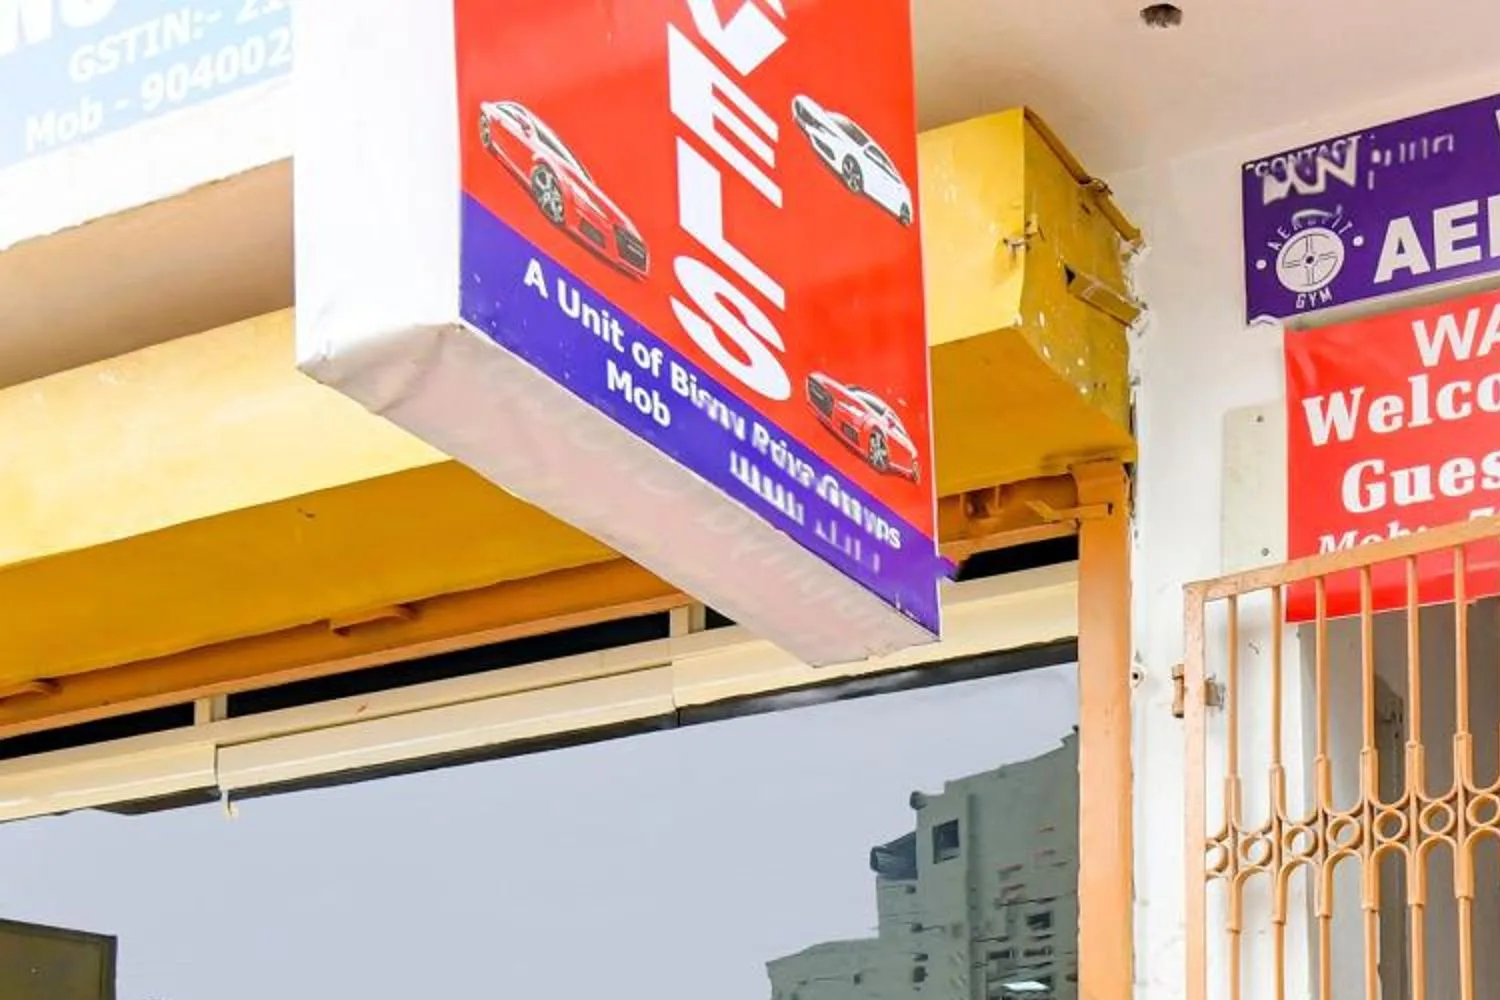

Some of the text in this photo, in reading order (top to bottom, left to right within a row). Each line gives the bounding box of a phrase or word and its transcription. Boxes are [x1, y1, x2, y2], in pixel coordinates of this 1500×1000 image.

[26, 97, 104, 153] Mob
[666, 0, 791, 401] VELS
[523, 257, 548, 300] A
[557, 276, 625, 353] Unit
[631, 340, 664, 378] of
[1295, 288, 1333, 310] GYM
[606, 358, 671, 428] Mob
